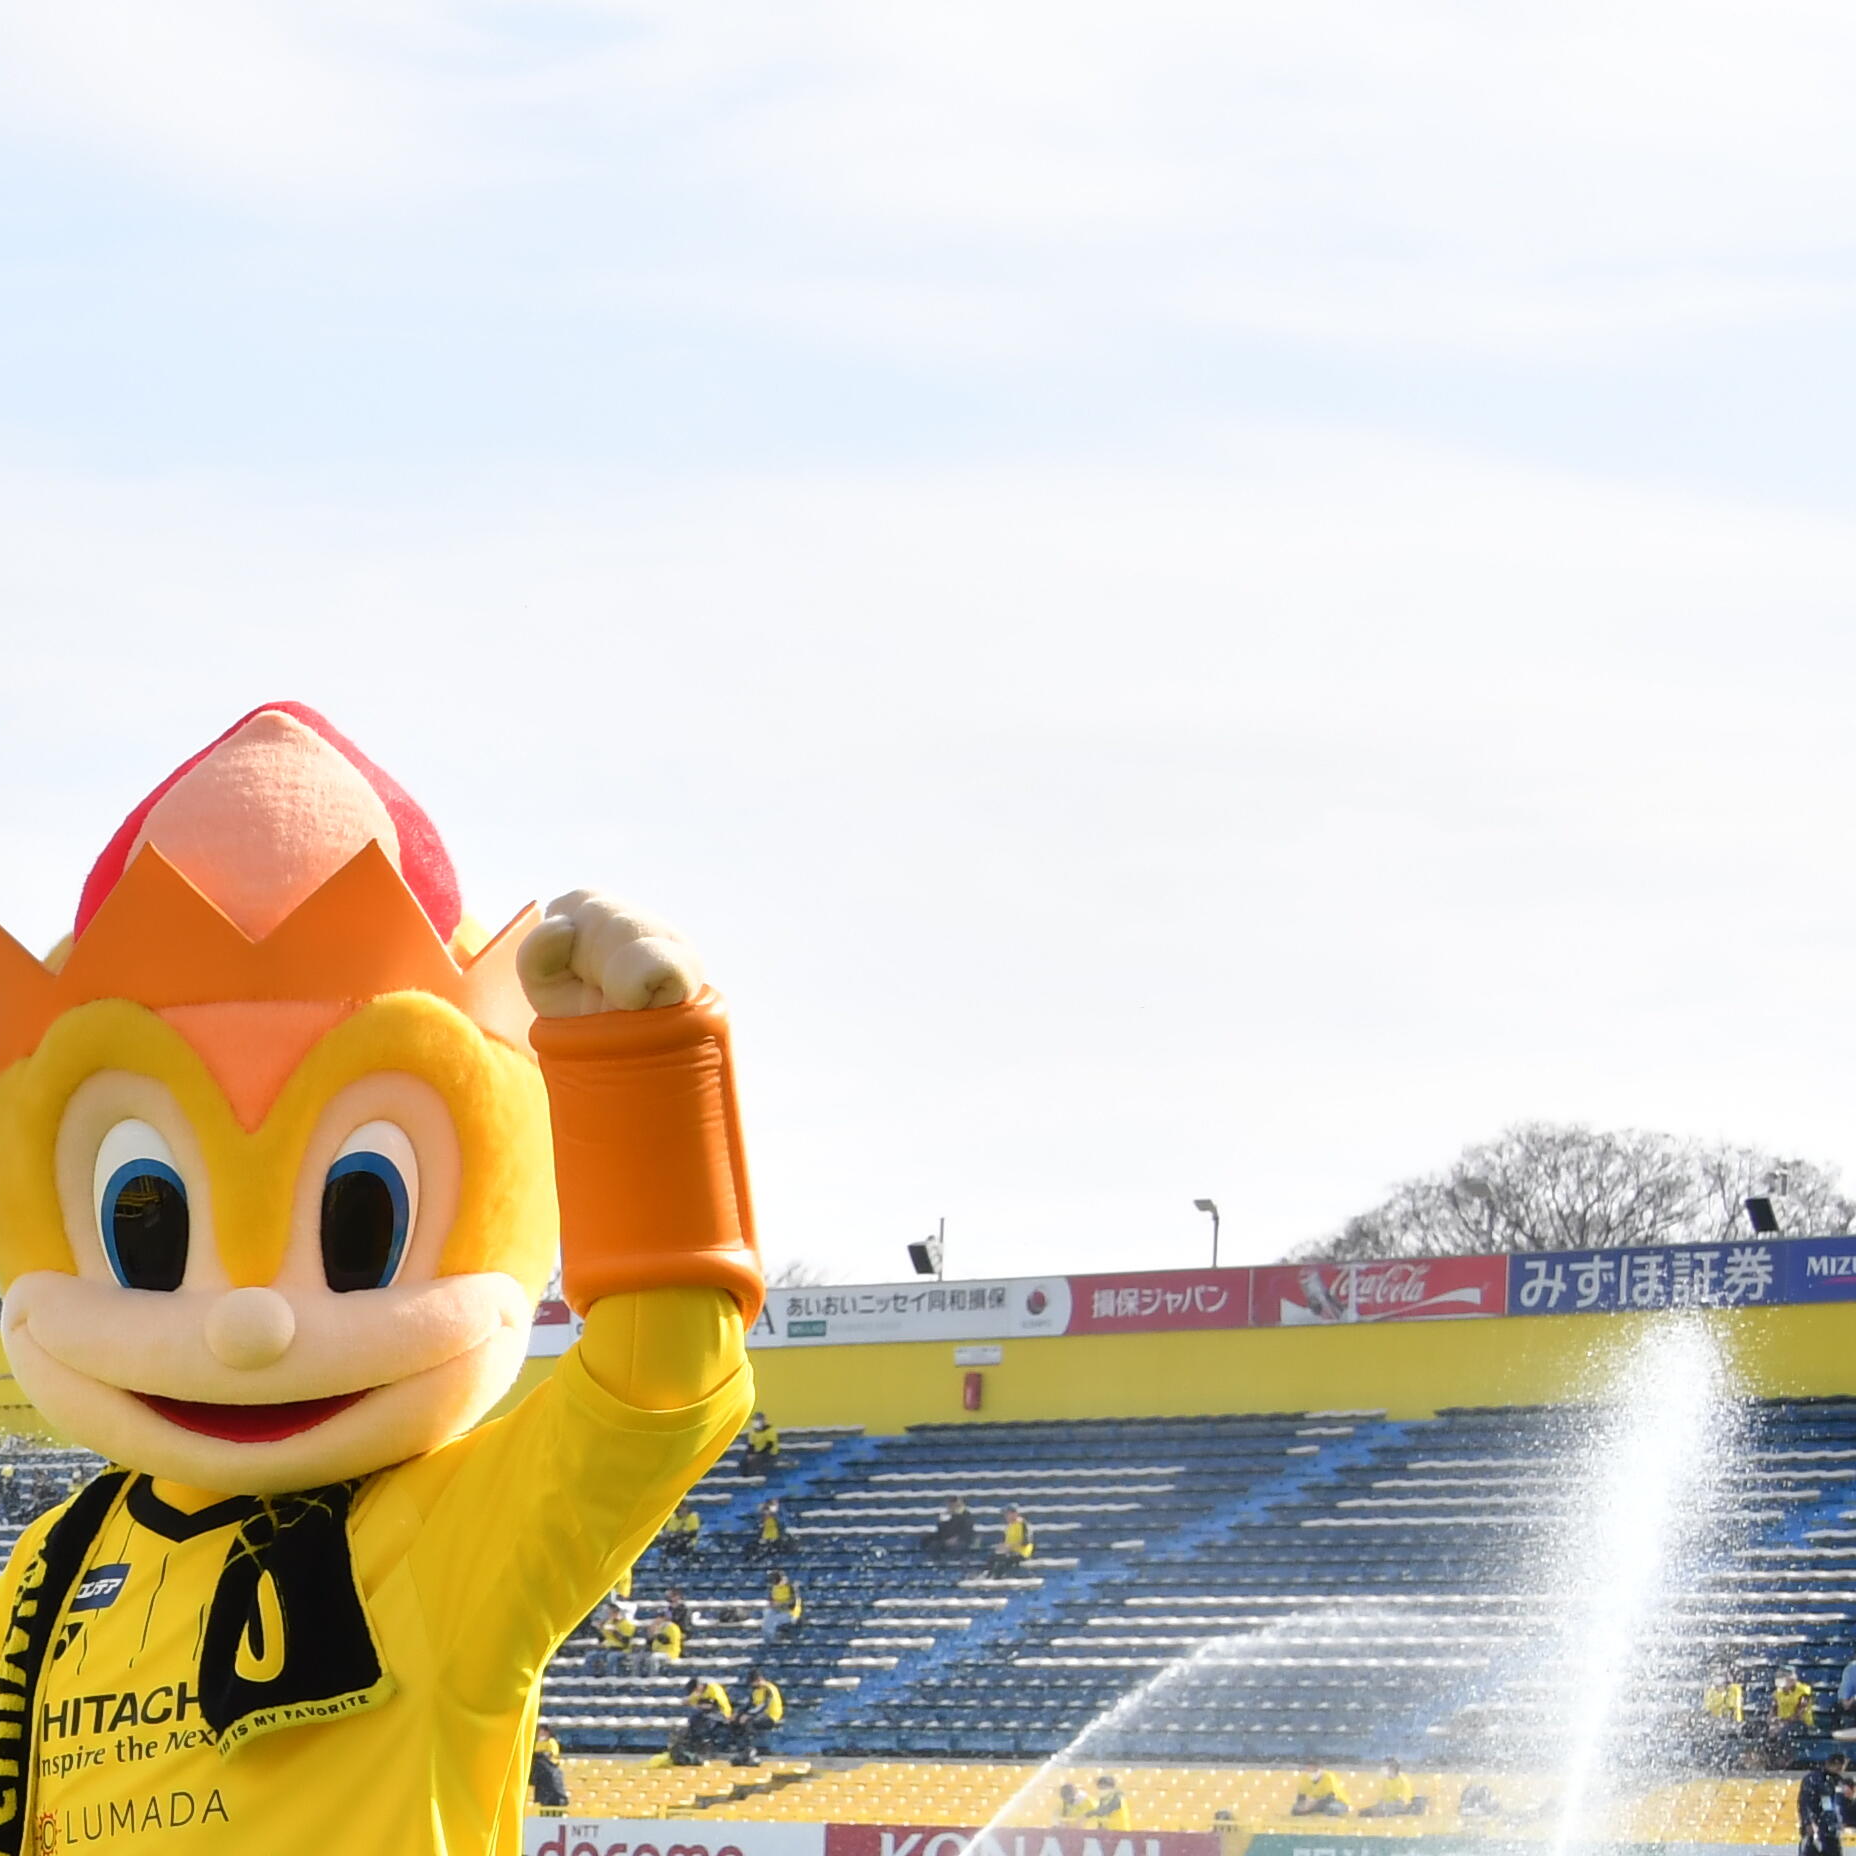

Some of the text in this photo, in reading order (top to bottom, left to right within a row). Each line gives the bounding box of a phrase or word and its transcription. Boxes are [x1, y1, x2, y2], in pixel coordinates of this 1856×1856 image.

[1520, 1246, 1774, 1308] みずほ証券
[1806, 1256, 1856, 1276] MIZ
[786, 1286, 1007, 1318] あいおいニッセイ同和損保
[1091, 1285, 1229, 1319] 損保ジャパン
[253, 1712, 278, 1728] MY
[115, 1736, 158, 1763] the
[66, 1788, 230, 1844] LUMADA
[571, 1825, 600, 1839] NTT
